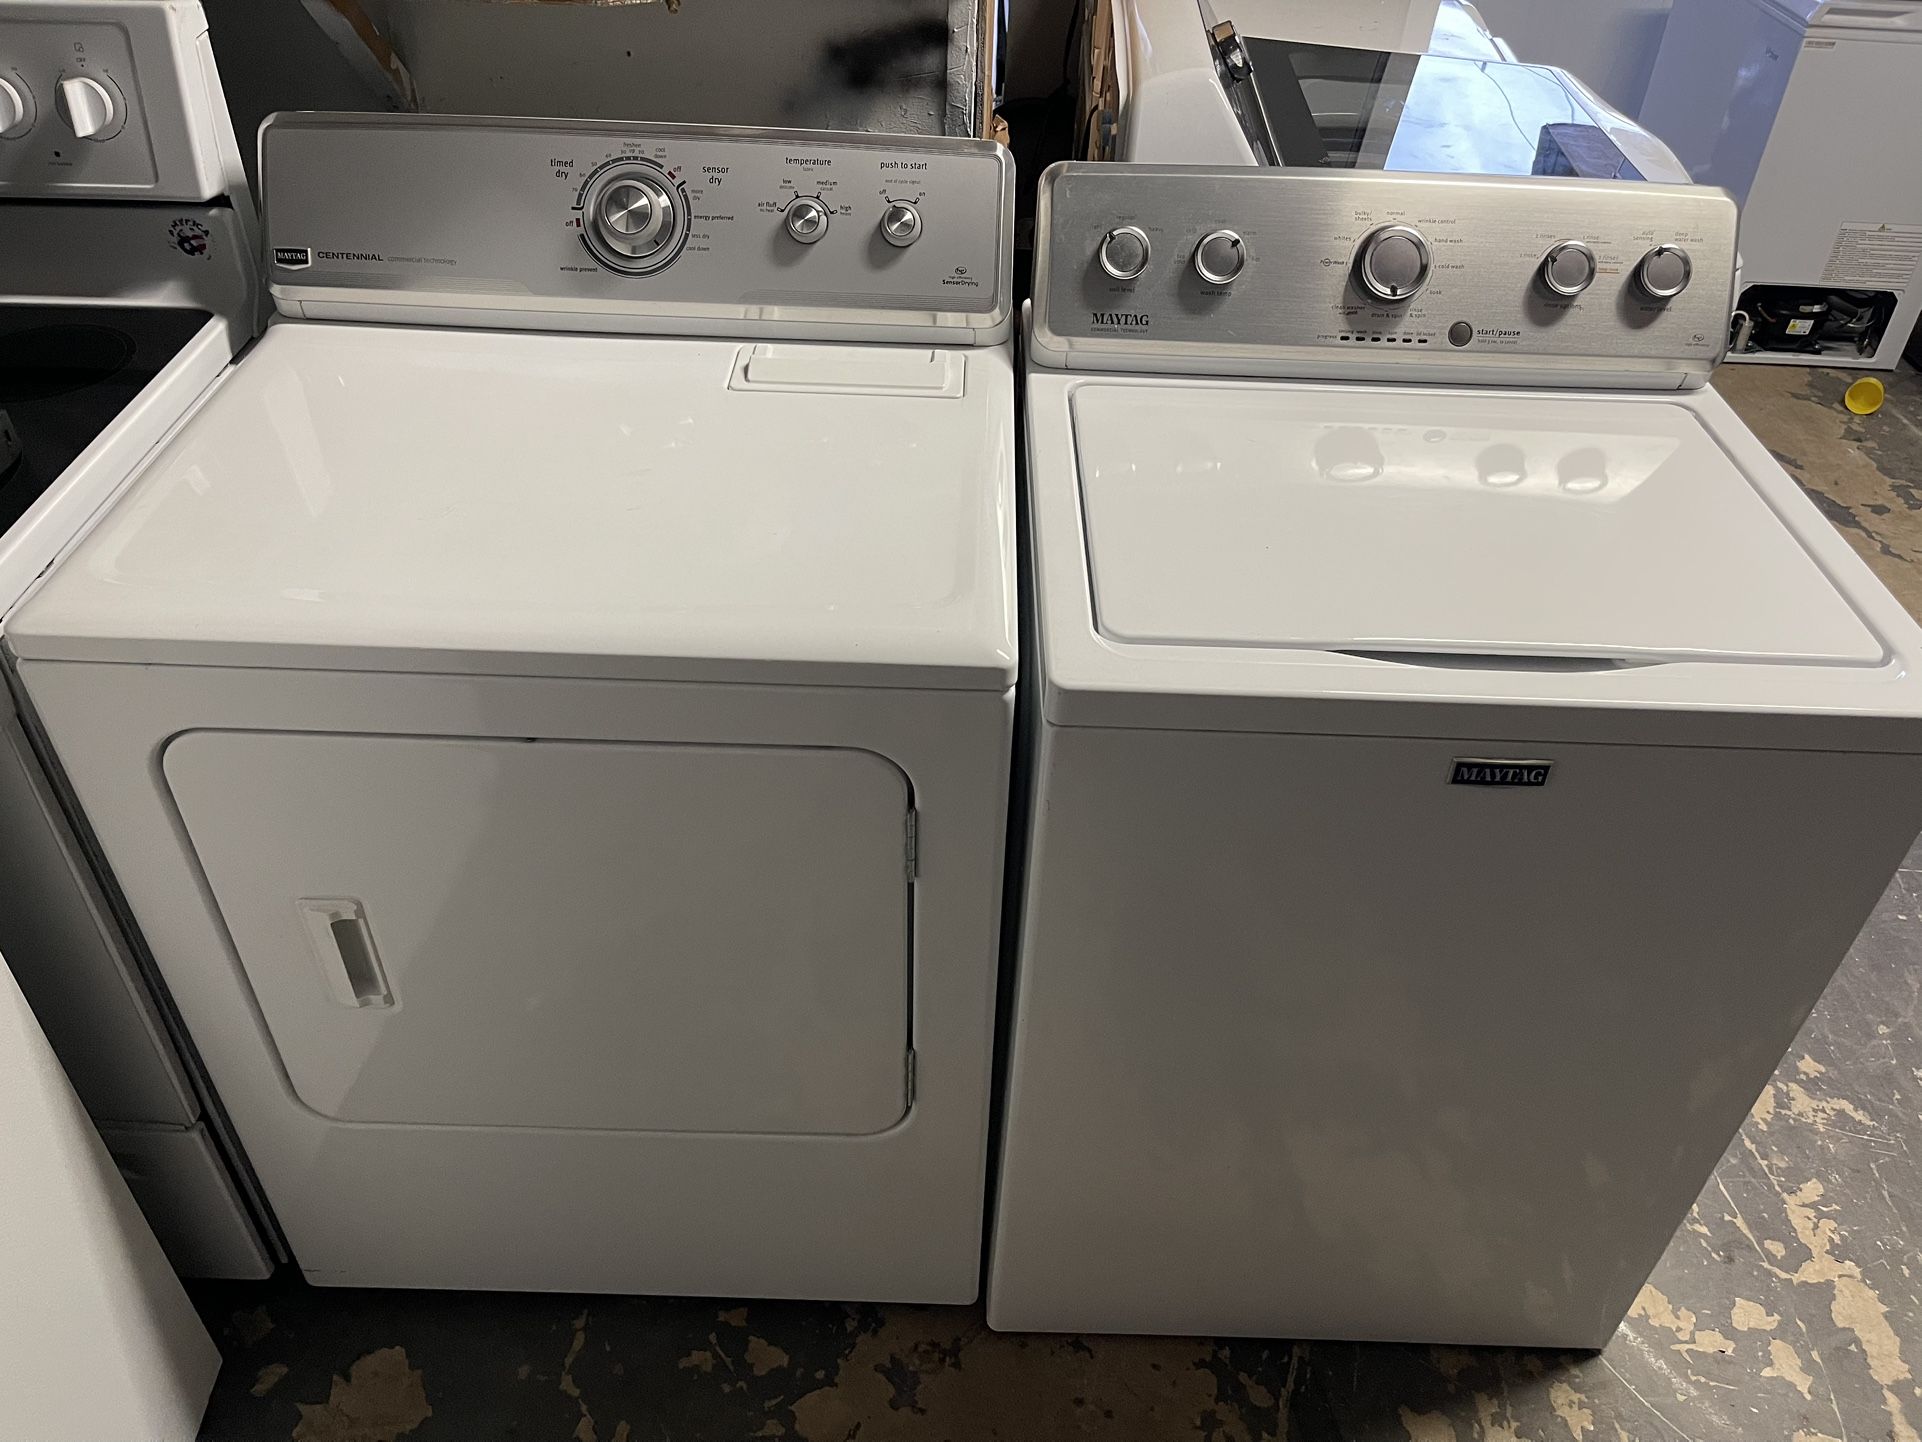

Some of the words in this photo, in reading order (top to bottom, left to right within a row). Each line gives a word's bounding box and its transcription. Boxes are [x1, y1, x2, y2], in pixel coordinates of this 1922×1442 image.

[550, 158, 574, 168] timed
[785, 156, 832, 167] temperature
[880, 160, 899, 170] push
[900, 162, 909, 170] to
[909, 162, 928, 170] start
[555, 169, 569, 180] dry
[672, 165, 682, 173] off
[702, 166, 730, 174] sensor
[708, 175, 722, 186] dry
[277, 251, 306, 261] MAYTAG
[317, 250, 384, 262] CENTENNIAL
[387, 255, 423, 263] commercial
[423, 257, 457, 266] technology
[942, 279, 979, 287] SensorDrying
[1091, 312, 1150, 326] MAYTAG
[1476, 327, 1521, 338] start/pause
[1457, 766, 1545, 783] MAYTAG
